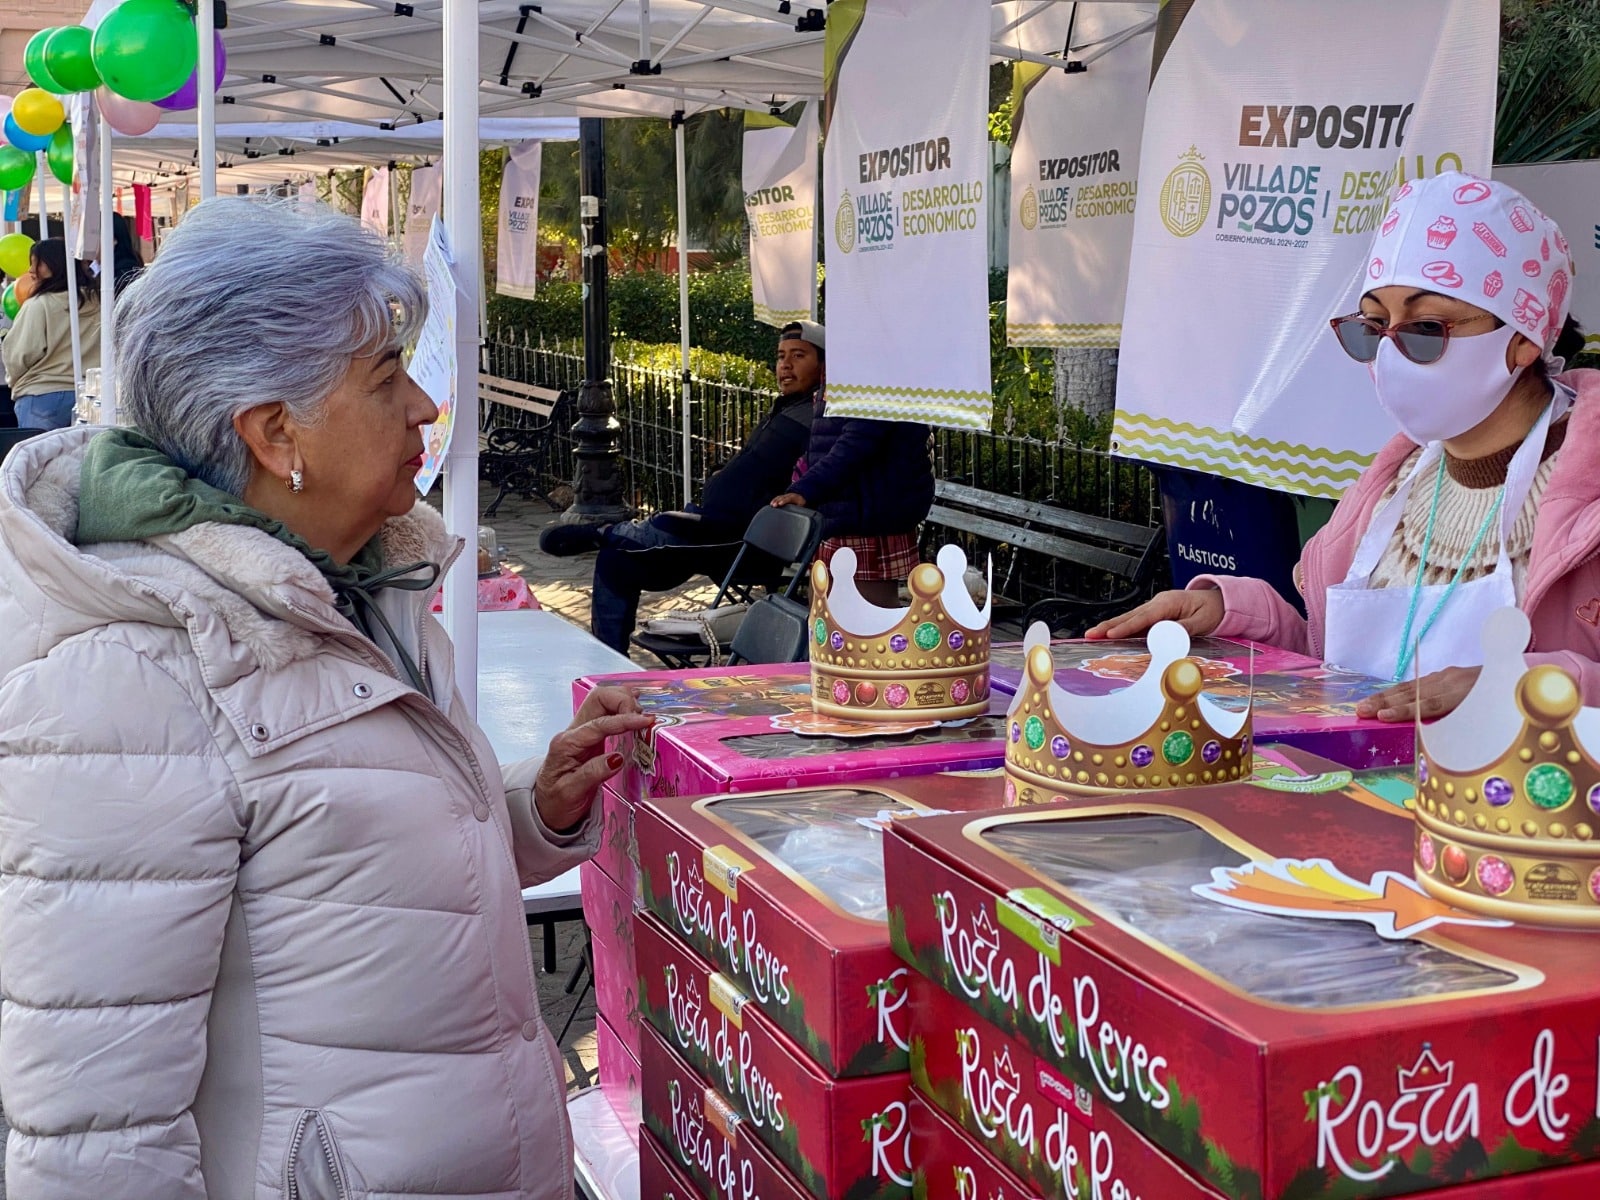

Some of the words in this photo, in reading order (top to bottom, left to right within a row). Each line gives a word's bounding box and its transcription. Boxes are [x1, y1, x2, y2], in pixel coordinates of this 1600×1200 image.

[859, 136, 951, 184] EXPOSITOR
[1039, 149, 1120, 181] EXPOSITOR
[1055, 186, 1070, 201] DE
[1223, 163, 1287, 194] VILLA
[1288, 165, 1321, 196] DE
[856, 193, 880, 216] VILLA
[880, 190, 893, 213] DE
[902, 180, 983, 213] DESARROLLO
[1075, 197, 1137, 219] ECONÓMIC
[857, 213, 894, 244] POZOS
[1217, 193, 1317, 236] POZOS
[1215, 233, 1246, 244] GOBIERNO
[1246, 236, 1277, 246] MUNICIPAL
[1277, 238, 1309, 249] 2024-2027
[1177, 543, 1237, 571] PLÁSTICOS
[668, 850, 714, 940] Rosca
[719, 895, 739, 974] de
[743, 908, 791, 1006] Reyes
[933, 889, 1019, 1010] Rosca
[1028, 951, 1066, 1058] de
[1072, 975, 1171, 1110] Reyes
[665, 963, 711, 1057] Rosca
[714, 1013, 734, 1094] de
[738, 1030, 784, 1132] Reyes
[957, 1027, 1035, 1155] Rosca
[1045, 1107, 1080, 1200] de
[1305, 1064, 1480, 1182] Rosca
[1504, 1028, 1571, 1142] de
[669, 1079, 714, 1178] Rosca
